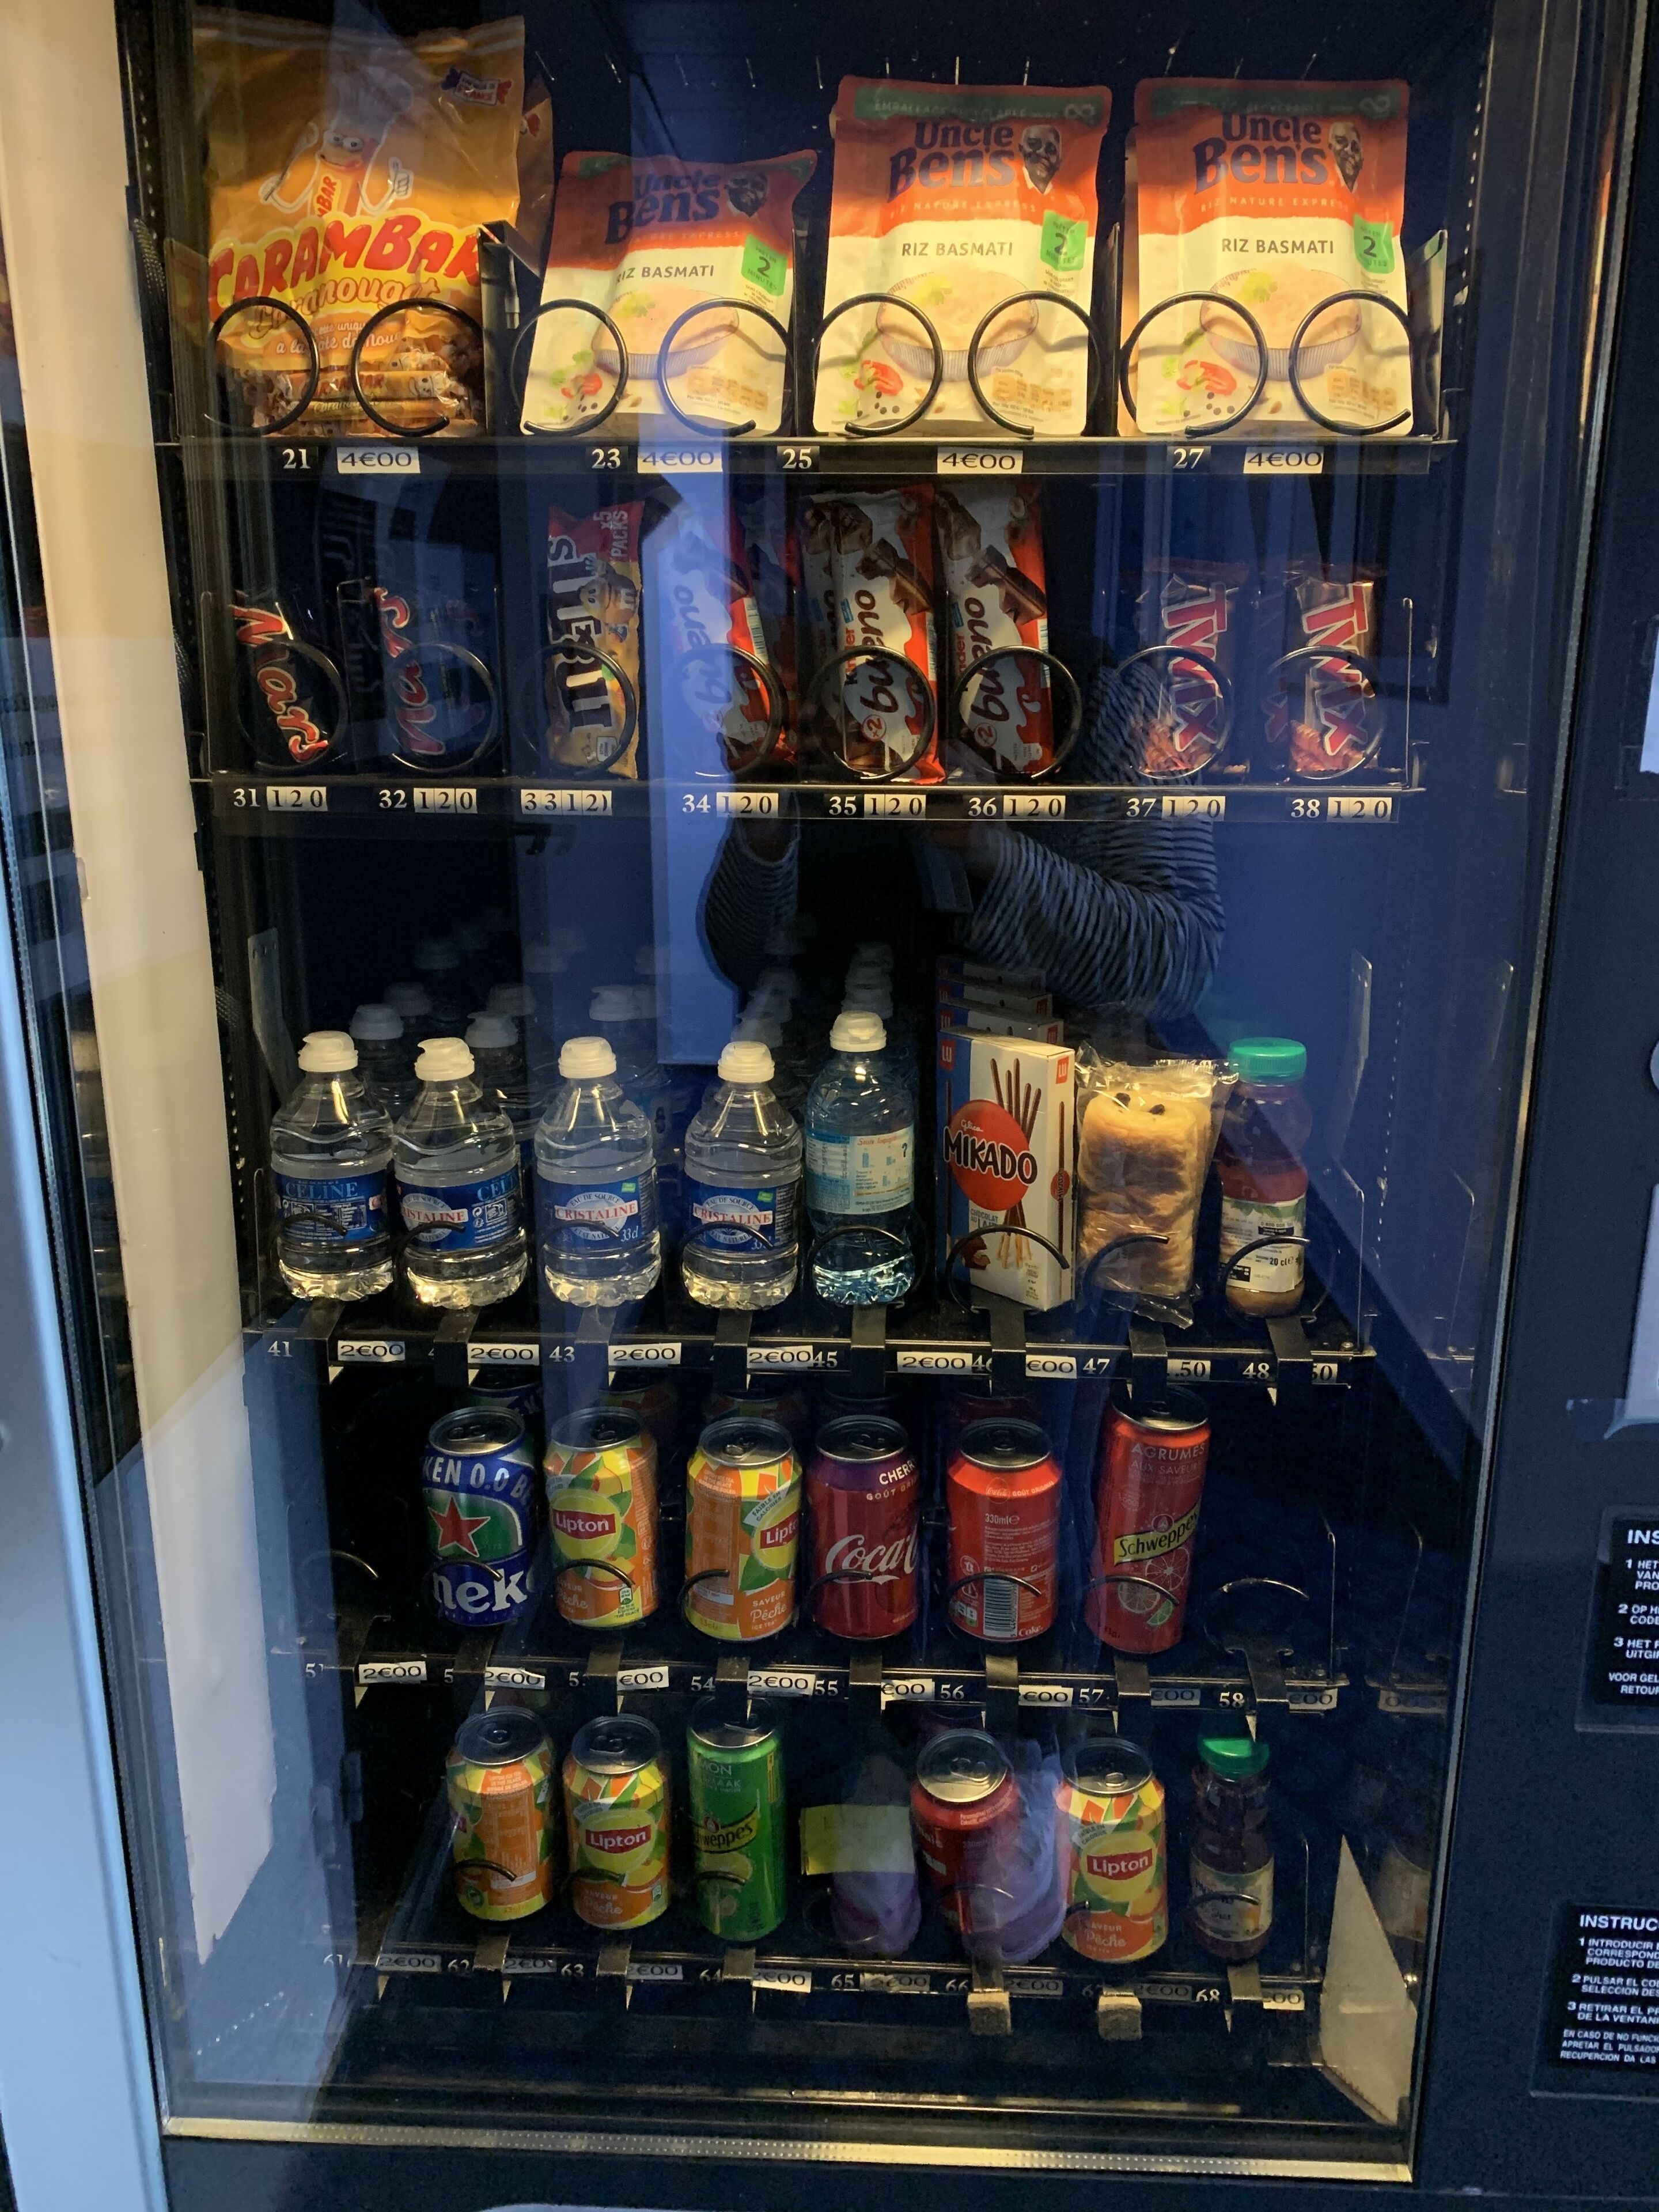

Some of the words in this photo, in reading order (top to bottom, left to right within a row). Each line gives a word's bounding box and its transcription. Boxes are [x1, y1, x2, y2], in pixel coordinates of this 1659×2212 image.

[915, 120, 1014, 150] Uncle
[1222, 114, 1321, 145] Uncle
[1192, 137, 1328, 195] Ben's
[634, 170, 721, 191] Uncle
[888, 146, 1015, 203] Ben's
[1230, 197, 1283, 207] NATURE
[902, 243, 929, 257] RIZ
[936, 243, 1013, 257] BASMATI
[1054, 232, 1067, 255] 2
[1222, 238, 1249, 253] RIZ
[1256, 238, 1335, 255] BASMATI
[1363, 236, 1377, 258] 2
[642, 264, 714, 278] BASMATI
[757, 255, 771, 278] 2
[282, 448, 311, 469] 21
[341, 452, 412, 467] 4€00
[592, 448, 621, 469] 23
[642, 451, 714, 466] 4€00
[783, 448, 812, 469] 25
[942, 453, 1016, 471] 4€00
[1173, 448, 1204, 469] 27
[1247, 452, 1322, 468] 4€00
[611, 509, 628, 558] PACKS
[855, 589, 899, 714] bueno
[965, 597, 1010, 723] bueno
[233, 788, 260, 808] 31
[271, 789, 324, 808] 120
[379, 789, 407, 809] 32
[418, 791, 474, 810] 120
[682, 794, 711, 814] 34
[719, 795, 772, 815] 120
[828, 796, 857, 817] 35
[869, 796, 923, 817] 120
[968, 796, 997, 817] 36
[1008, 798, 1062, 817] 120
[1126, 797, 1157, 817] 37
[1166, 800, 1221, 818] 120
[1290, 798, 1320, 818] 38
[1332, 800, 1389, 819] 120
[942, 1046, 953, 1063] LU
[1058, 1062, 1067, 1078] LU
[942, 1126, 1038, 1185] MIKADO
[594, 1194, 619, 1203] SOURCE
[729, 1198, 754, 1211] SOURCE
[402, 1206, 464, 1222] RISTALINE
[556, 1203, 637, 1221] CRISTALINE
[694, 1206, 771, 1225] CRISTALINE
[970, 1208, 999, 1223] CHOCOLAT
[621, 1225, 639, 1242] 33cl
[1270, 1257, 1279, 1266] 20
[340, 1344, 404, 1357] 2€00
[470, 1347, 533, 1360] 2€00
[549, 1346, 575, 1363] 43
[613, 1347, 676, 1361] 2€00
[749, 1350, 812, 1363] 2€00
[813, 1351, 838, 1368] 45
[902, 1355, 965, 1369] 2€00
[1083, 1358, 1110, 1375] 47
[1242, 1362, 1270, 1380] 48
[1131, 1443, 1205, 1461] AGRUMES
[1131, 1460, 1153, 1471] AUX
[469, 1463, 510, 1492] 0.0
[866, 1488, 896, 1500] GOÛT
[752, 1493, 774, 1516] FAIBLE
[555, 1513, 609, 1533] Lipton
[1626, 1558, 1633, 1569] 1
[1638, 1560, 1659, 1570] HET
[1637, 1570, 1659, 1580] VAN
[752, 1590, 786, 1607] SAVEUR
[750, 1600, 787, 1624] Pêche
[1618, 1603, 1628, 1614] 2
[1631, 1604, 1647, 1614] OP
[1613, 1636, 1624, 1647] 3
[1627, 1639, 1652, 1649] HET
[363, 1665, 422, 1679] 2€00
[485, 1671, 540, 1684] 2€00
[1609, 1672, 1637, 1682] VOOR
[691, 1676, 715, 1691] 54
[748, 1675, 808, 1690] 2€00
[815, 1680, 839, 1696] 55
[940, 1684, 965, 1700] 56
[1079, 1688, 1104, 1703] 57
[1219, 1692, 1245, 1708] 58
[590, 1832, 646, 1850] Lipton
[1092, 1855, 1149, 1876] Lipton
[1580, 1915, 1658, 1931] INSTRUC
[1579, 1936, 1585, 1946] 1
[1588, 1938, 1653, 1950] INTRODUCIR
[380, 1958, 435, 1968] 2€00
[561, 1963, 584, 1977] 63
[1585, 1957, 1644, 1968] PRODUCTO
[699, 1968, 722, 1984] 64
[831, 1974, 855, 1988] 65
[1571, 1973, 1581, 1983] 2
[1583, 1975, 1624, 1986] PULSAR
[1626, 1978, 1638, 1987] EL
[945, 1978, 969, 1992] 66
[1581, 1984, 1639, 1996] SELECCION
[1195, 1989, 1220, 2002] 68
[1567, 2001, 1577, 2011] 3
[1578, 2003, 1627, 2014] RETIRAR
[1630, 2005, 1643, 2015] EL
[1577, 2012, 1593, 2021] DE
[1595, 2012, 1610, 2022] LA
[1563, 2028, 1575, 2038] EN
[1577, 2029, 1601, 2040] CASO
[1603, 2031, 1615, 2041] DE
[1616, 2032, 1629, 2041] NO
[1562, 2040, 1599, 2050] APRETAR
[1603, 2042, 1613, 2051] EL
[1623, 2052, 1635, 2063] DA
[1639, 2053, 1657, 2065] LAS
